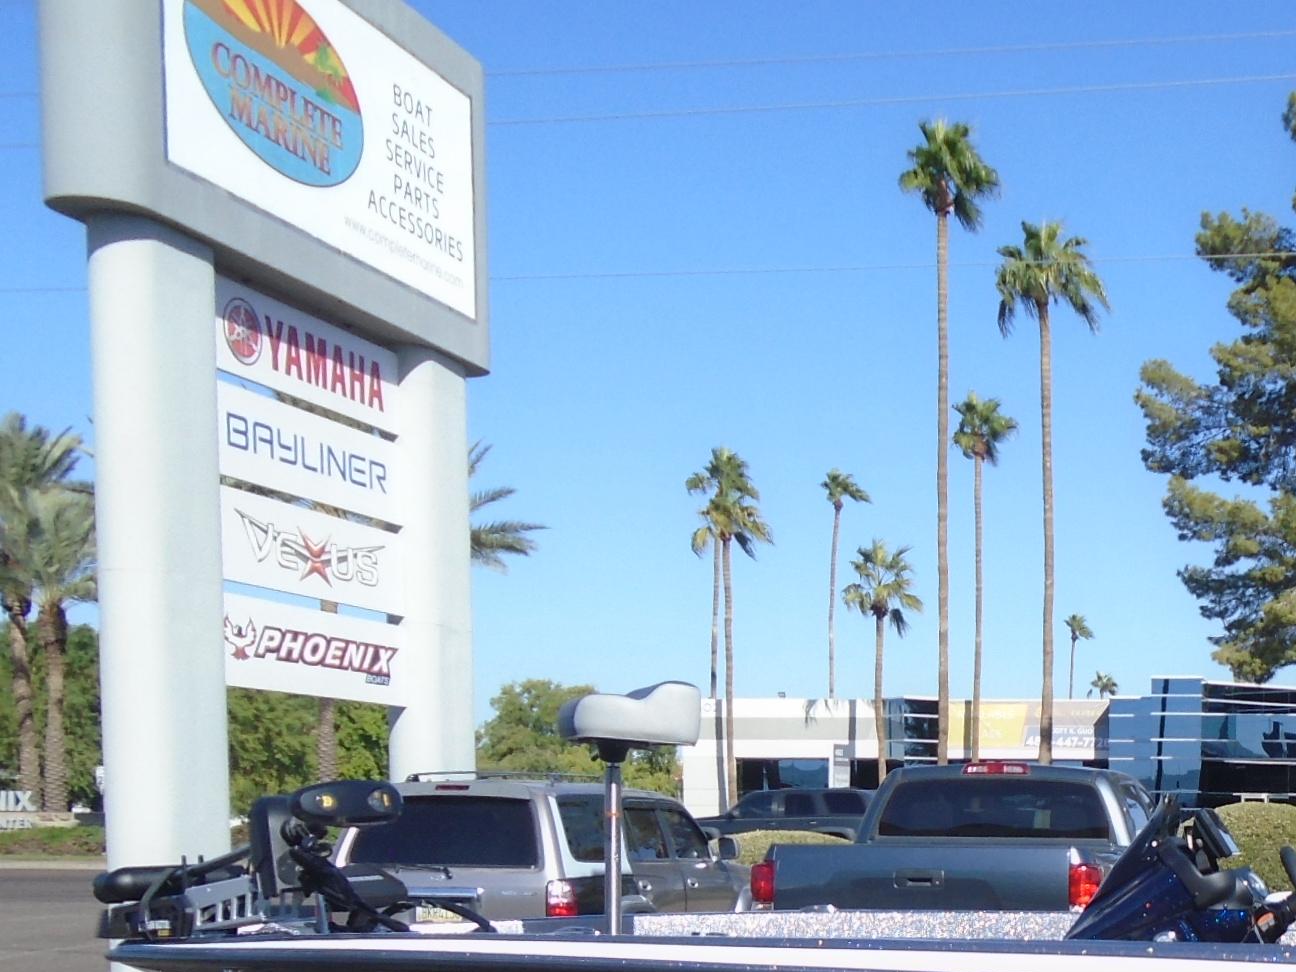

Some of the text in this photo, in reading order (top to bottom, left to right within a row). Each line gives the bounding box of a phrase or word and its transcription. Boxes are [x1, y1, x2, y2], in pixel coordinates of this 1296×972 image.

[211, 42, 344, 148] COMPLETE
[393, 83, 433, 127] BOAT
[229, 89, 332, 176] MARINE
[385, 139, 445, 194] SERVICE
[392, 113, 436, 159] SALES
[367, 189, 464, 262] ACCESSORIES
[394, 174, 440, 219] PARTS
[264, 315, 385, 413] YAMAHA
[227, 411, 388, 494] BAYLINER
[234, 508, 387, 588] VEXUS
[256, 624, 398, 675] PHOENIX
